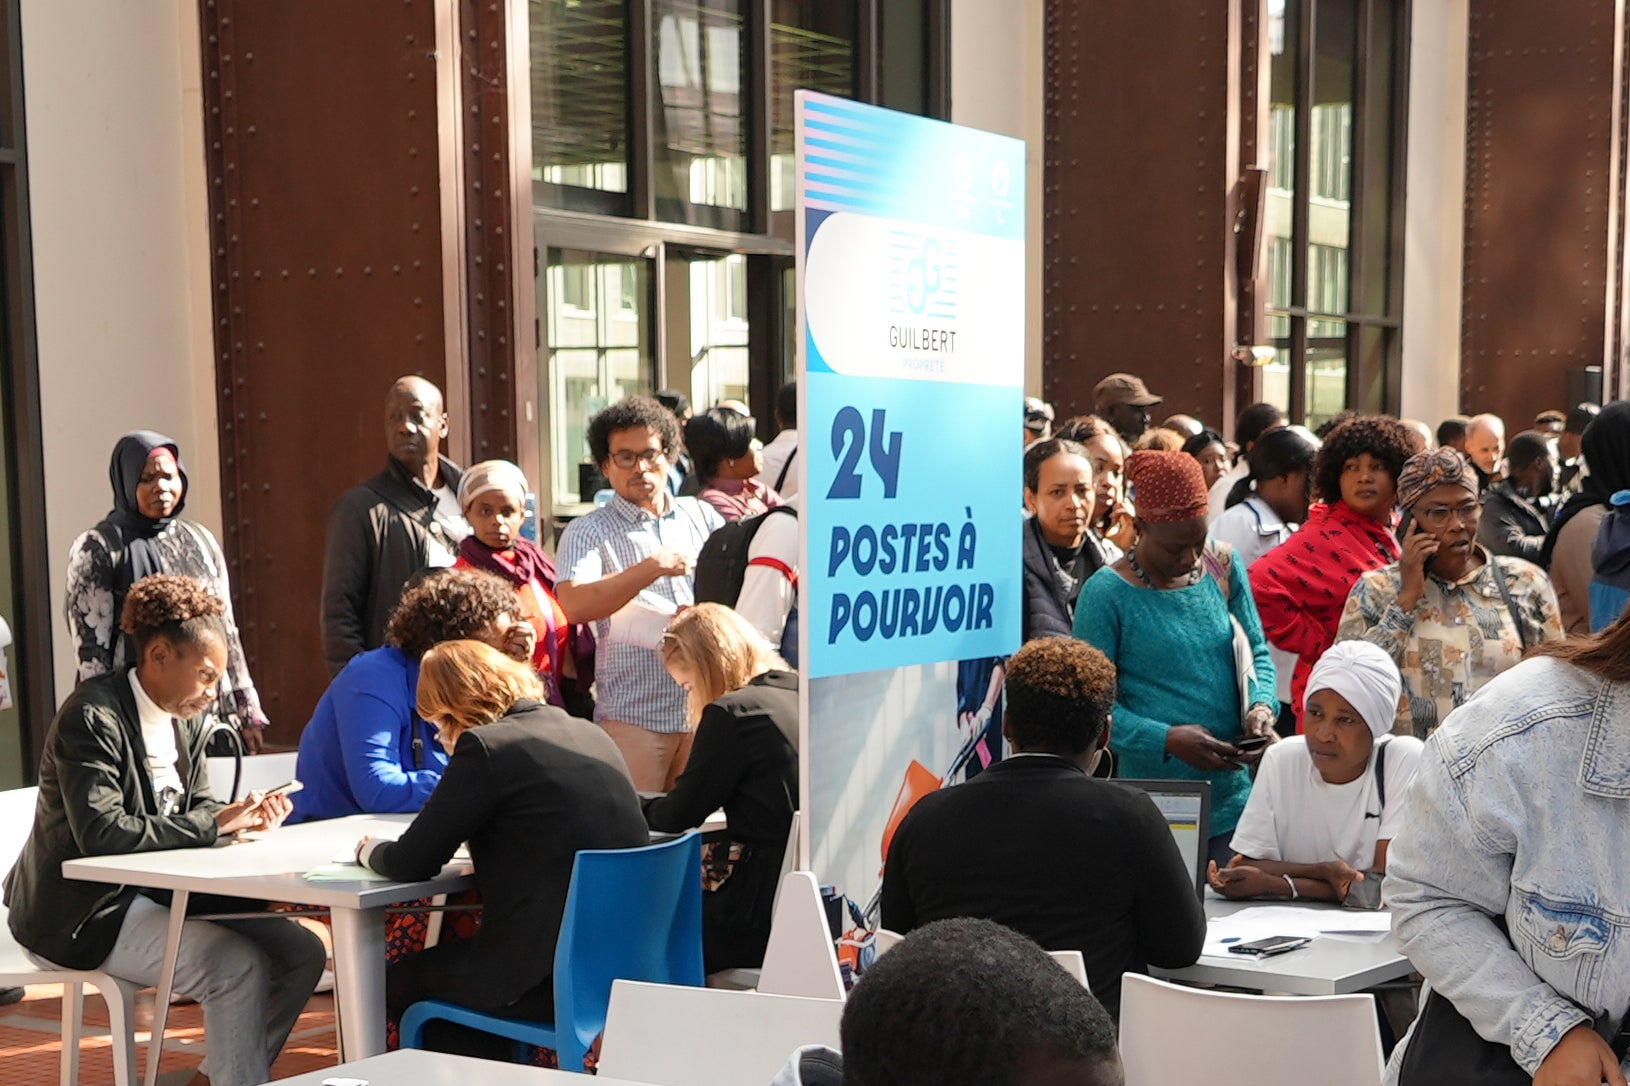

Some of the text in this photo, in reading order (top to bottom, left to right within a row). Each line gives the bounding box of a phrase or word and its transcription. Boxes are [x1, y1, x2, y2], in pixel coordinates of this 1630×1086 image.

[889, 325, 957, 353] GUILBERT
[825, 405, 903, 500] 24
[827, 506, 977, 577] POSTES À
[827, 582, 995, 645] POURVOIR
